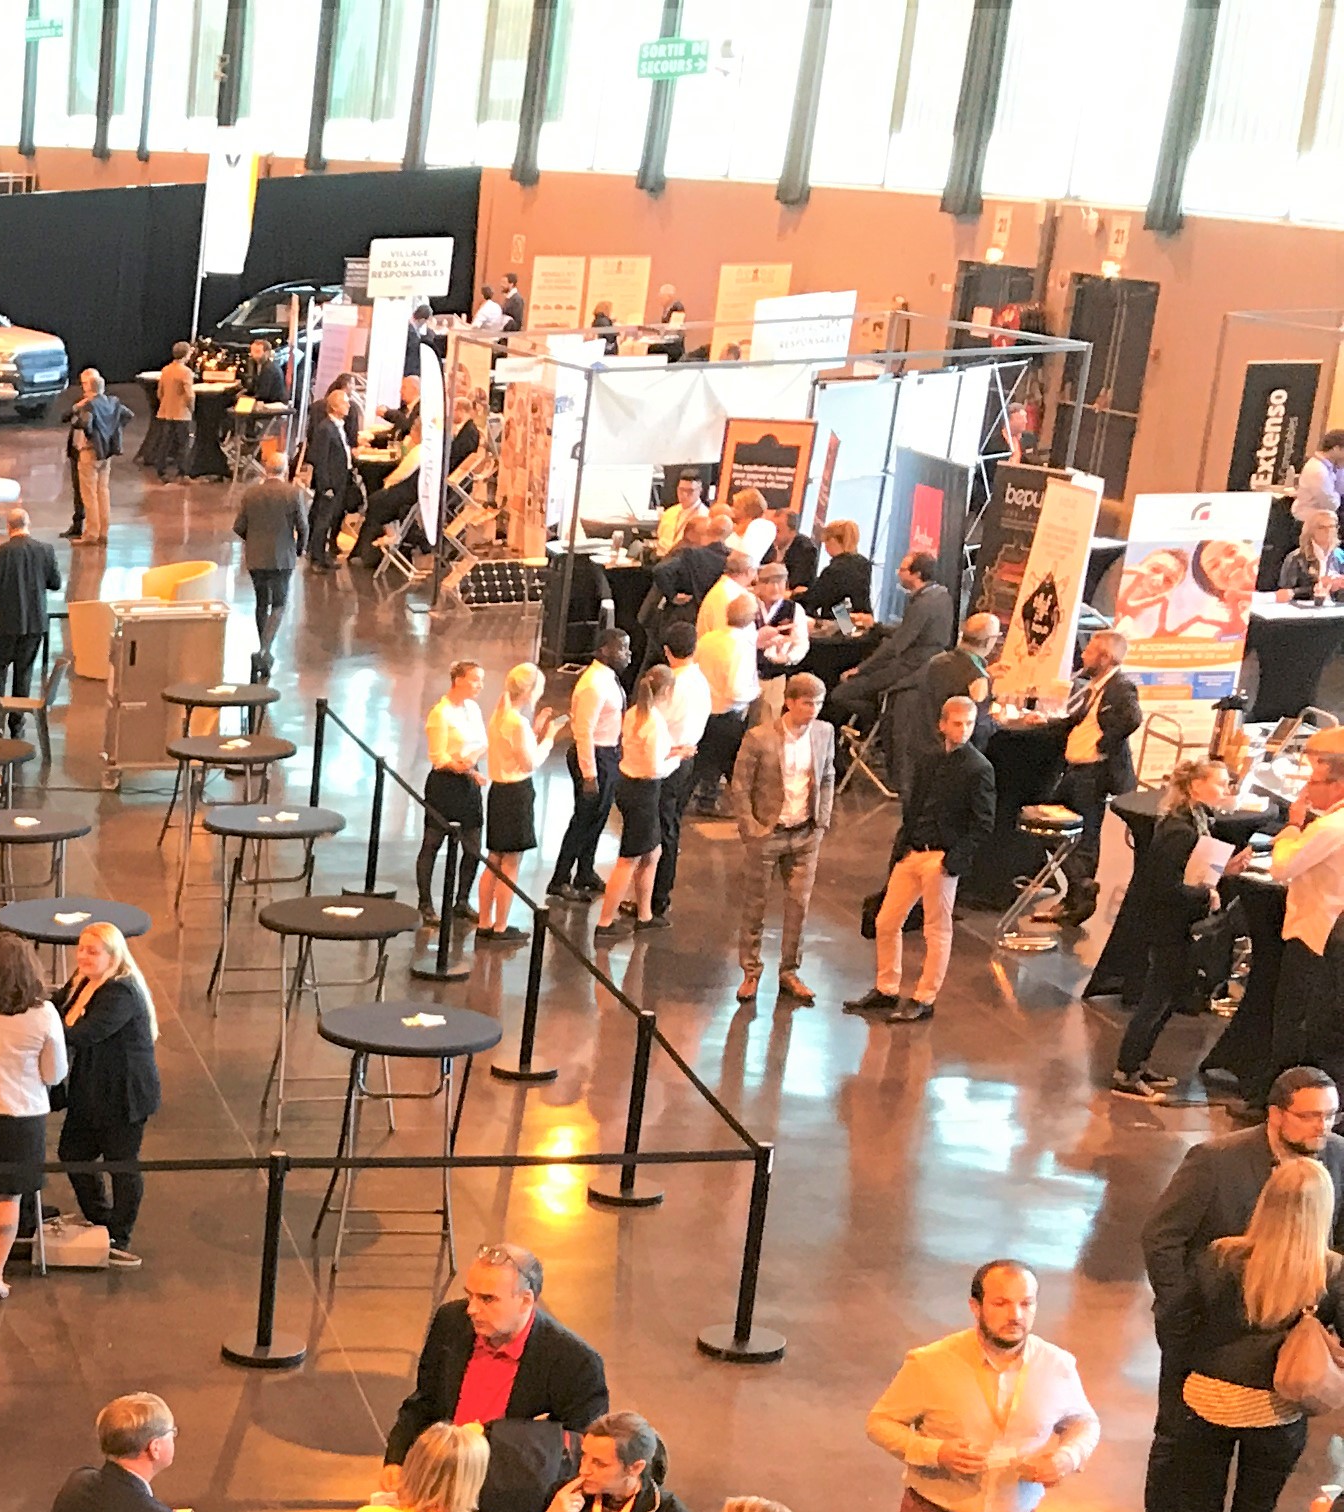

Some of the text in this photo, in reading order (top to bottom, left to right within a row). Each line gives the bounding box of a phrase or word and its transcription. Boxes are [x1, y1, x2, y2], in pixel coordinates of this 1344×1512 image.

[641, 42, 707, 58] SORTIE DE
[640, 59, 692, 74] SECOURS
[391, 250, 428, 258] VILLAGE
[381, 260, 436, 269] DES ACHATS
[372, 269, 444, 279] RESPONSABLES
[1250, 389, 1288, 489] Extenso
